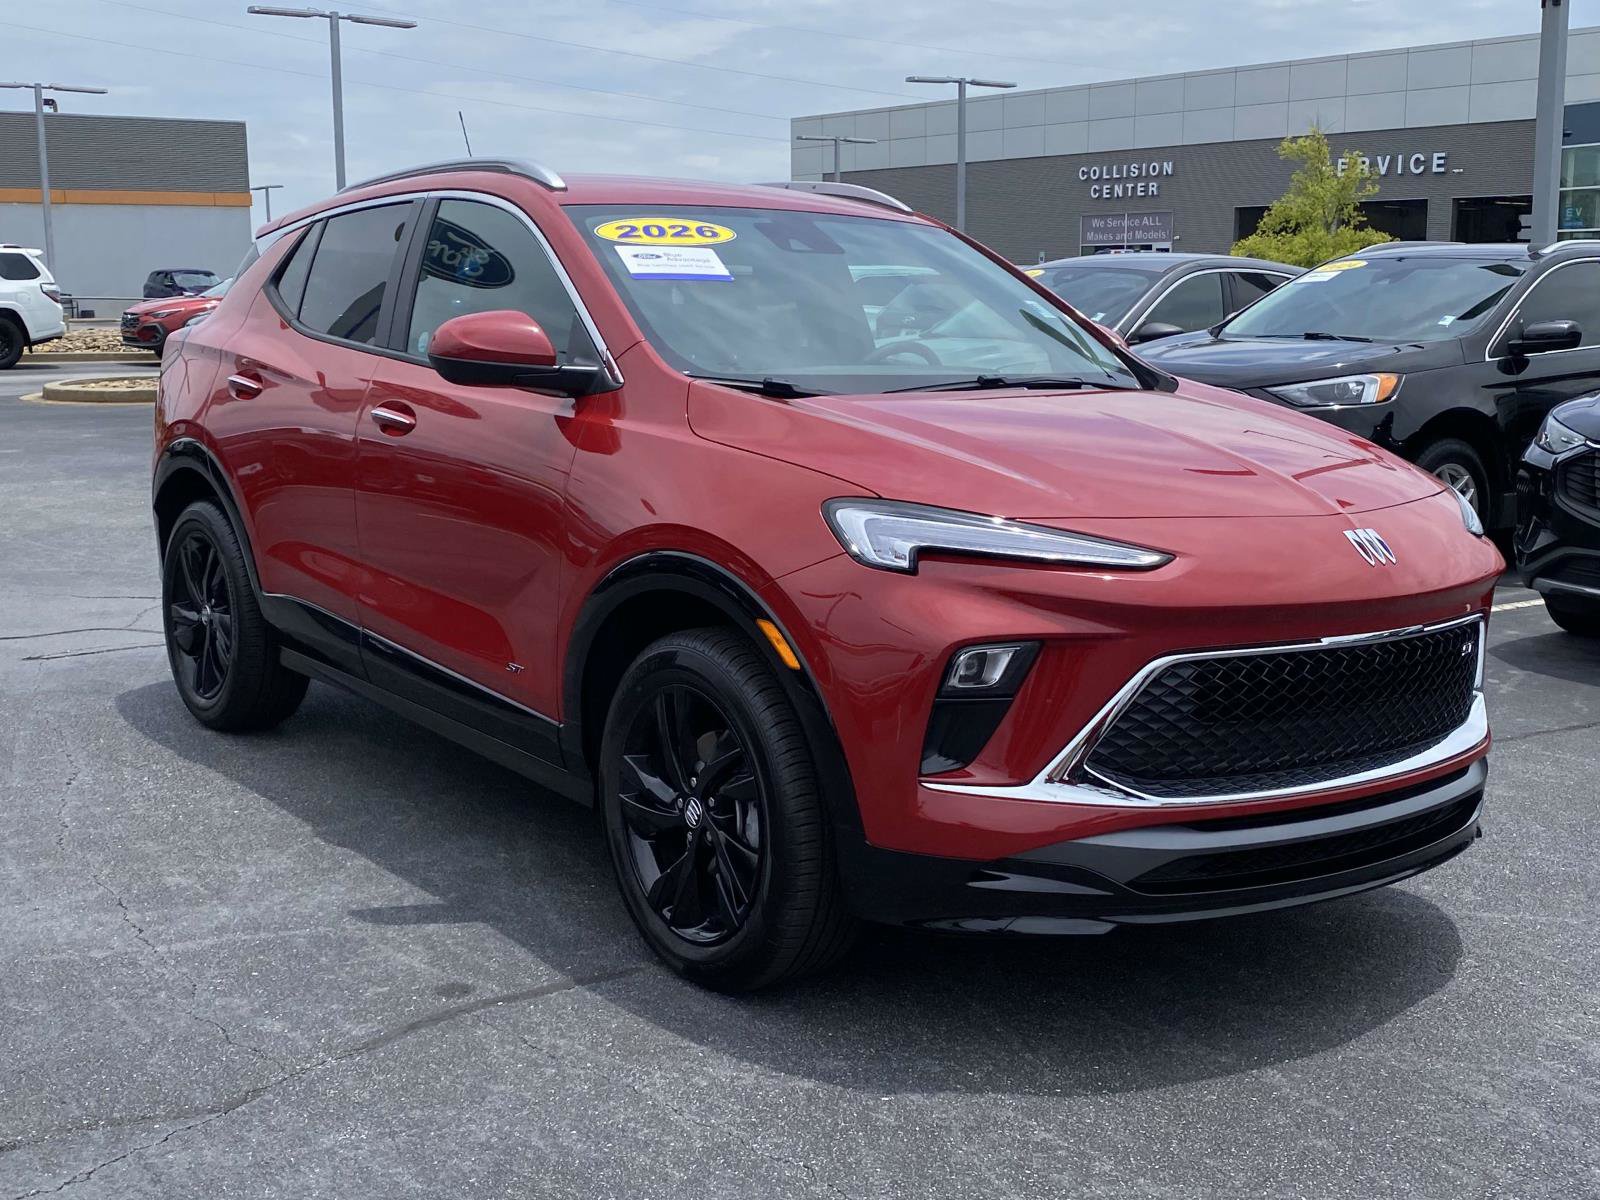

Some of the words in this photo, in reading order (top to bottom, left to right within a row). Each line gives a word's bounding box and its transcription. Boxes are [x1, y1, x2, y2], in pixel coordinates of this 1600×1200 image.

[1079, 161, 1173, 180] COLLISION
[1336, 152, 1446, 177] ERVICE
[1090, 182, 1158, 198] CENTER
[1092, 218, 1105, 228] We
[1107, 217, 1140, 228] Service
[1142, 216, 1162, 226] ALL
[615, 224, 720, 239] 2026
[1086, 231, 1114, 241] Makes
[1116, 230, 1133, 241] and
[1135, 229, 1170, 240] Models!
[505, 662, 525, 674] ST
